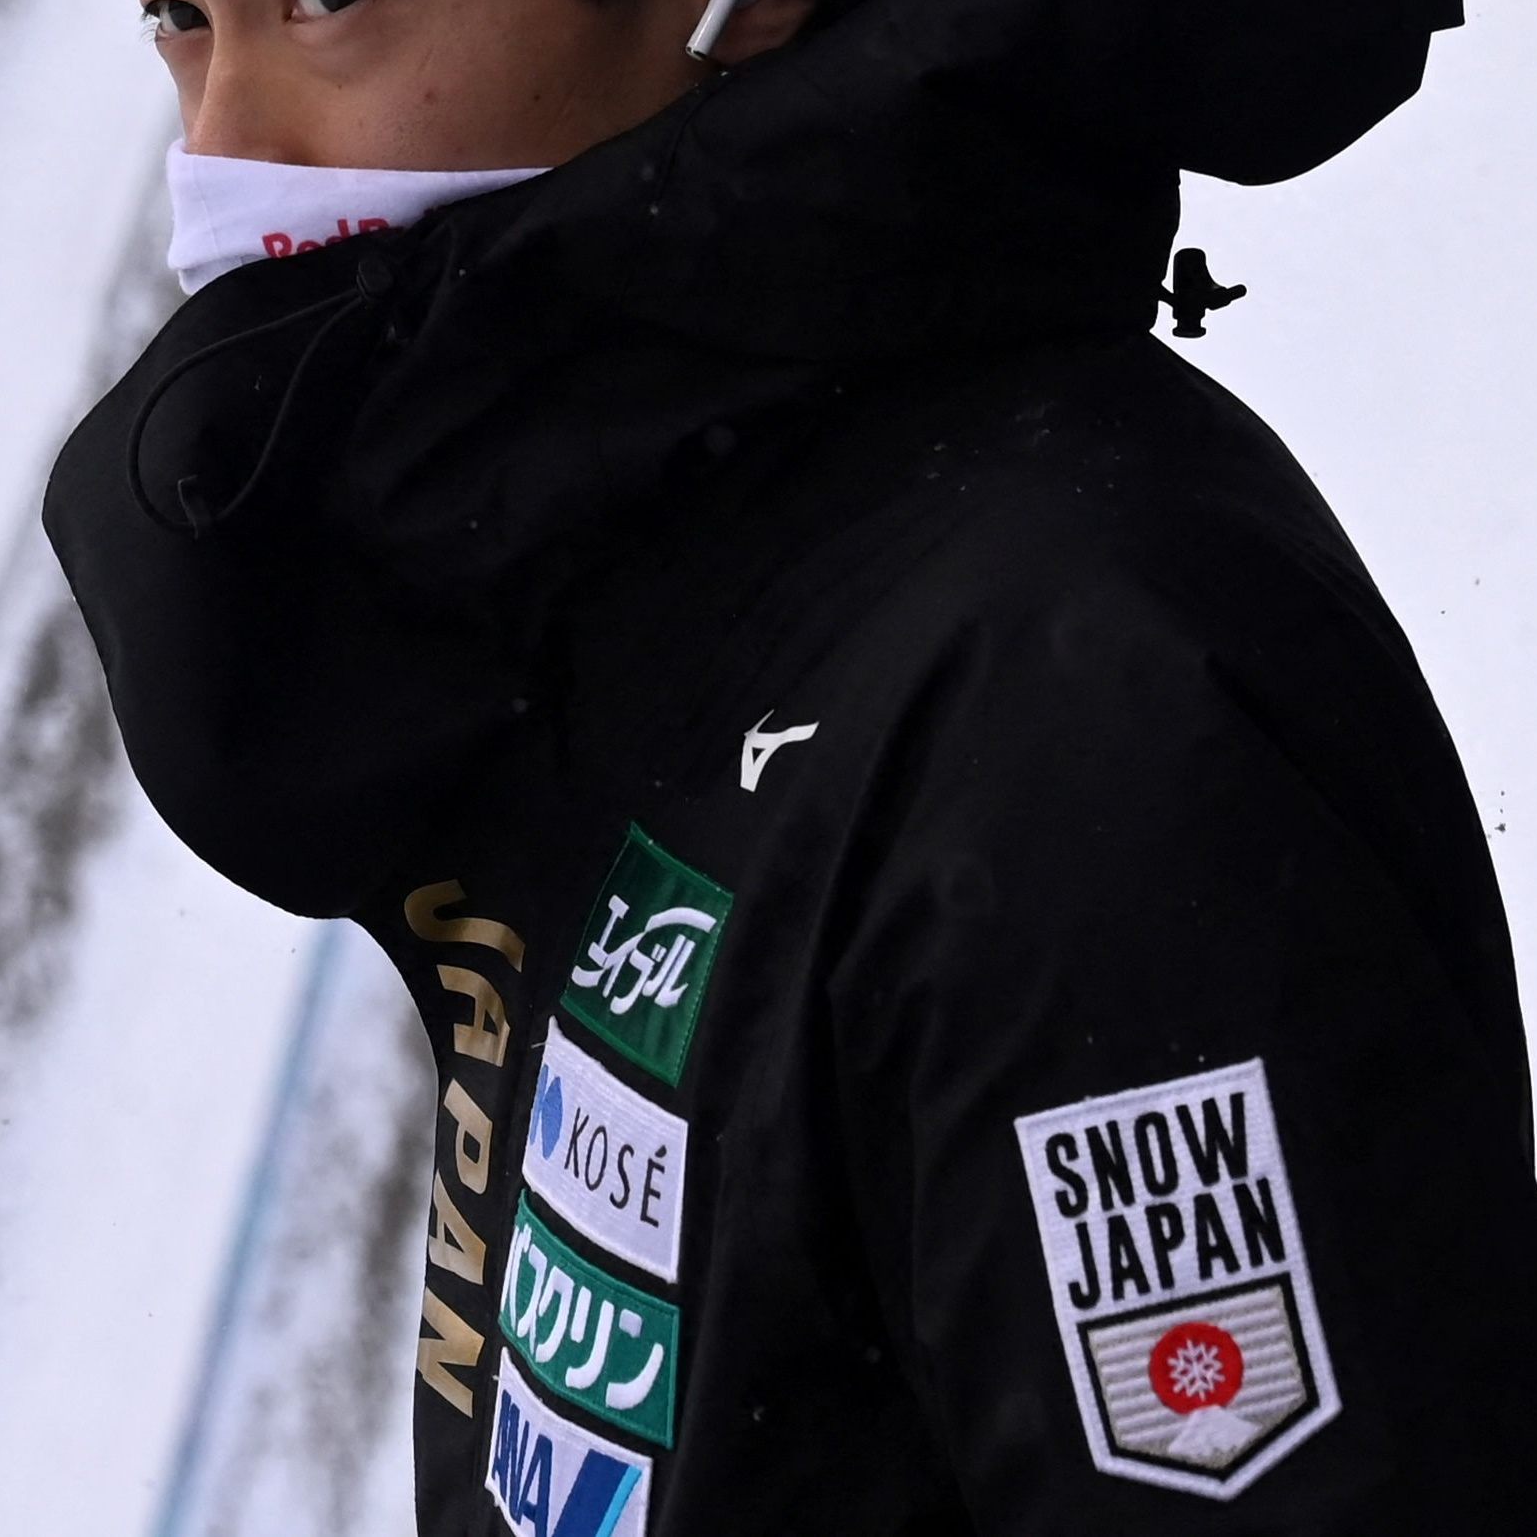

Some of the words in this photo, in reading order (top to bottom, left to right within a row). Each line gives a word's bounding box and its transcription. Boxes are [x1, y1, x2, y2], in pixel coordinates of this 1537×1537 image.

[571, 894, 717, 1015] エイブル
[404, 879, 527, 1418] JAPAN
[564, 1106, 667, 1228] KOSÉ
[1045, 1092, 1249, 1219] SNOW
[1068, 1176, 1287, 1311] JAPAN
[500, 1222, 665, 1411] バスクリン
[491, 1388, 554, 1537] ANA
